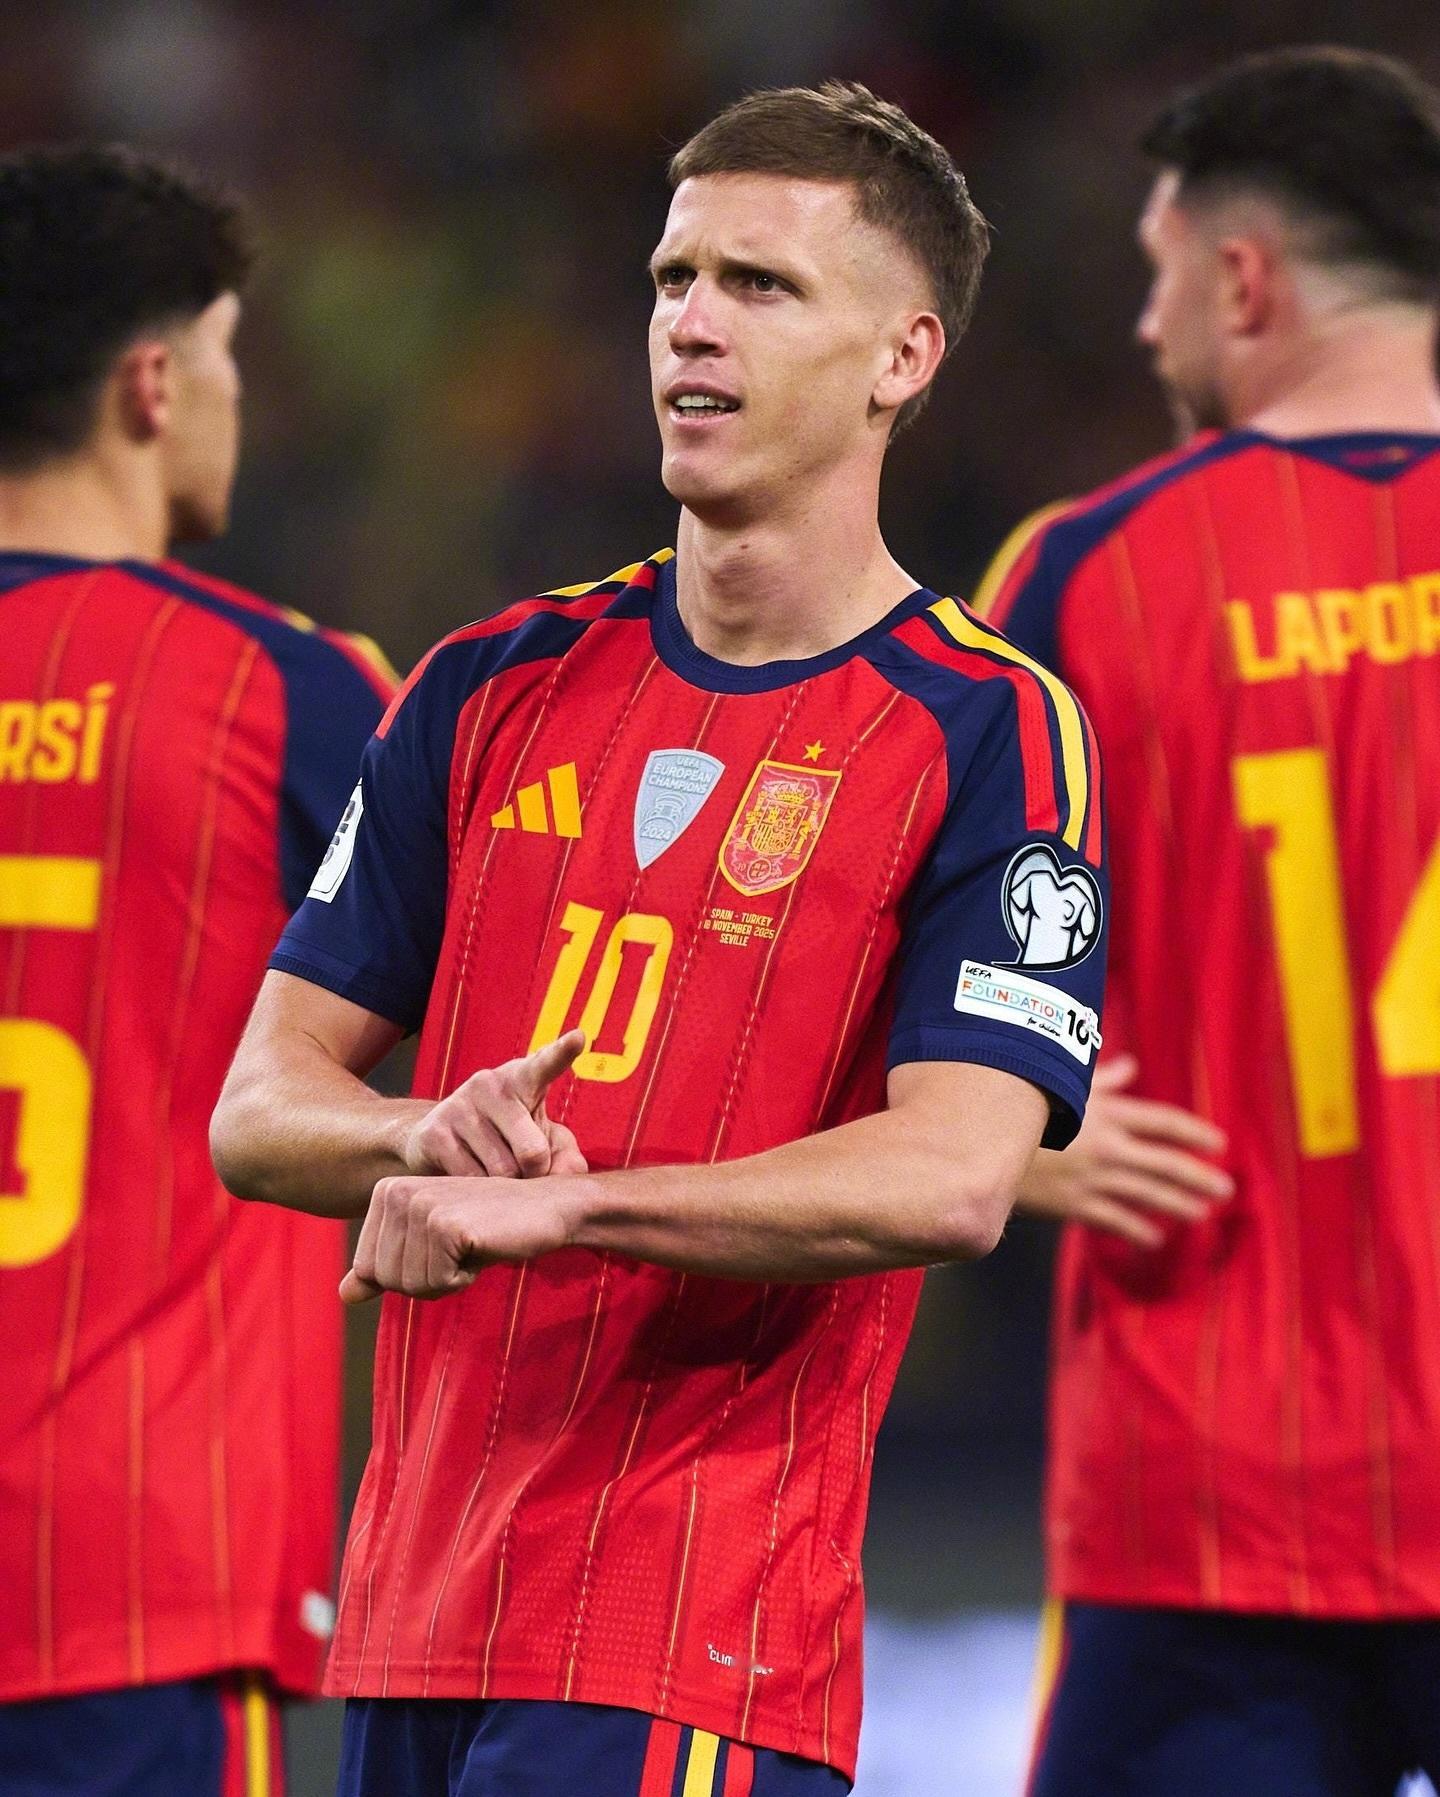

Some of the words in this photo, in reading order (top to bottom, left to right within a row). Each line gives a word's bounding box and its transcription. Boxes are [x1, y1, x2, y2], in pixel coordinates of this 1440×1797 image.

[652, 763, 712, 784] EUROPEAN
[648, 774, 708, 794] CHAMPIONS
[642, 825, 672, 840] 2024
[710, 908, 734, 921] SPAIN
[742, 912, 773, 927] TURKEY
[712, 920, 752, 936] NOVEMBER
[753, 926, 775, 940] 2025
[720, 933, 749, 947] SEVILLE
[965, 965, 992, 979] UEFA
[526, 900, 673, 1083] 10
[962, 979, 1064, 1024] FOUNDATION
